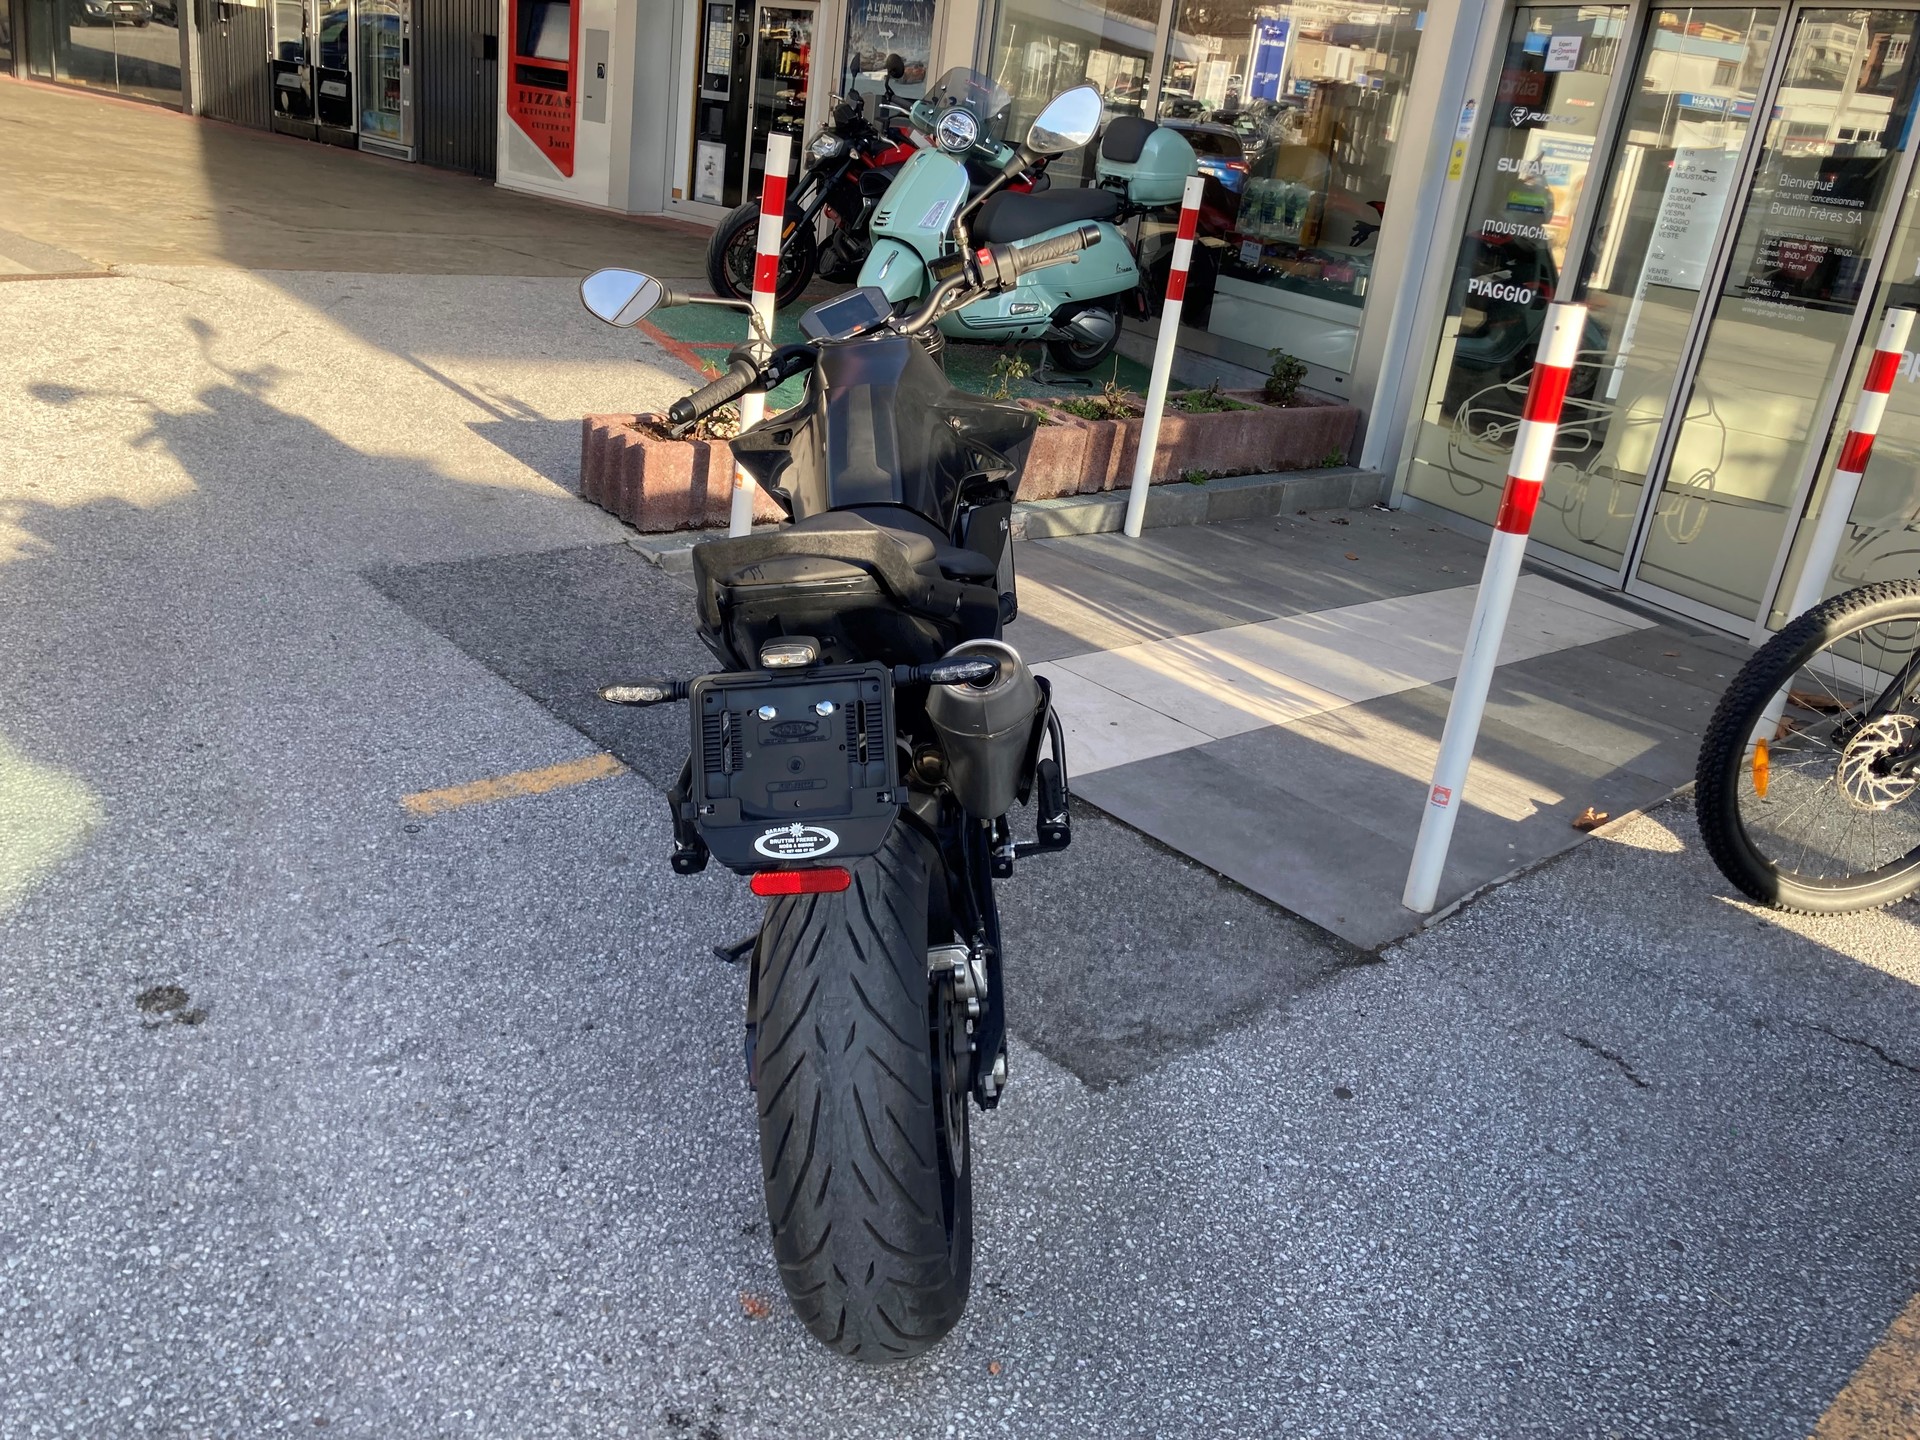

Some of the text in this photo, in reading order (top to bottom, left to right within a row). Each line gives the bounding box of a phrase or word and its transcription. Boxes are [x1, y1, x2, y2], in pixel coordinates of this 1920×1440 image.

[518, 90, 572, 108] PIZZAS
[518, 107, 571, 119] ARTISANALES
[531, 121, 559, 131] CUITES
[1497, 157, 1567, 178] SUBARU
[1677, 164, 1696, 172] EXPO
[1675, 172, 1718, 183] MOUSTACHE
[1779, 173, 1834, 192] Bienvenue
[1670, 186, 1690, 195] EXPO
[1668, 195, 1697, 203] SUBARU
[1775, 191, 1865, 208] chez votre concessionnaire
[1666, 202, 1692, 210] APRILIA
[1664, 209, 1686, 217] VESPA
[1770, 201, 1863, 225] Bruttin Frères SA
[1662, 217, 1690, 226] PIAGGIO
[1482, 219, 1551, 241] MOUSTACHE
[1660, 223, 1688, 234] CASQUE
[1765, 228, 1780, 237] Nous
[1780, 230, 1805, 240] sommes
[1658, 232, 1680, 240] VESTE
[1761, 238, 1778, 247] Lundi
[1833, 247, 1853, 257] 18h00
[1651, 252, 1666, 261] REZ
[1759, 247, 1779, 257] Samedi
[1784, 250, 1800, 260] 8h00
[1805, 253, 1824, 264] 13h00
[1756, 256, 1784, 269] Dimanche
[1787, 261, 1808, 272] Fermé
[1647, 267, 1670, 275] VENTE
[1645, 274, 1673, 284] SUBARU
[1750, 276, 1771, 286] Contact
[1468, 278, 1532, 305] PIAGGIO
[1747, 285, 1790, 299] 027 455 07 20
[765, 826, 789, 835] GARAGE
